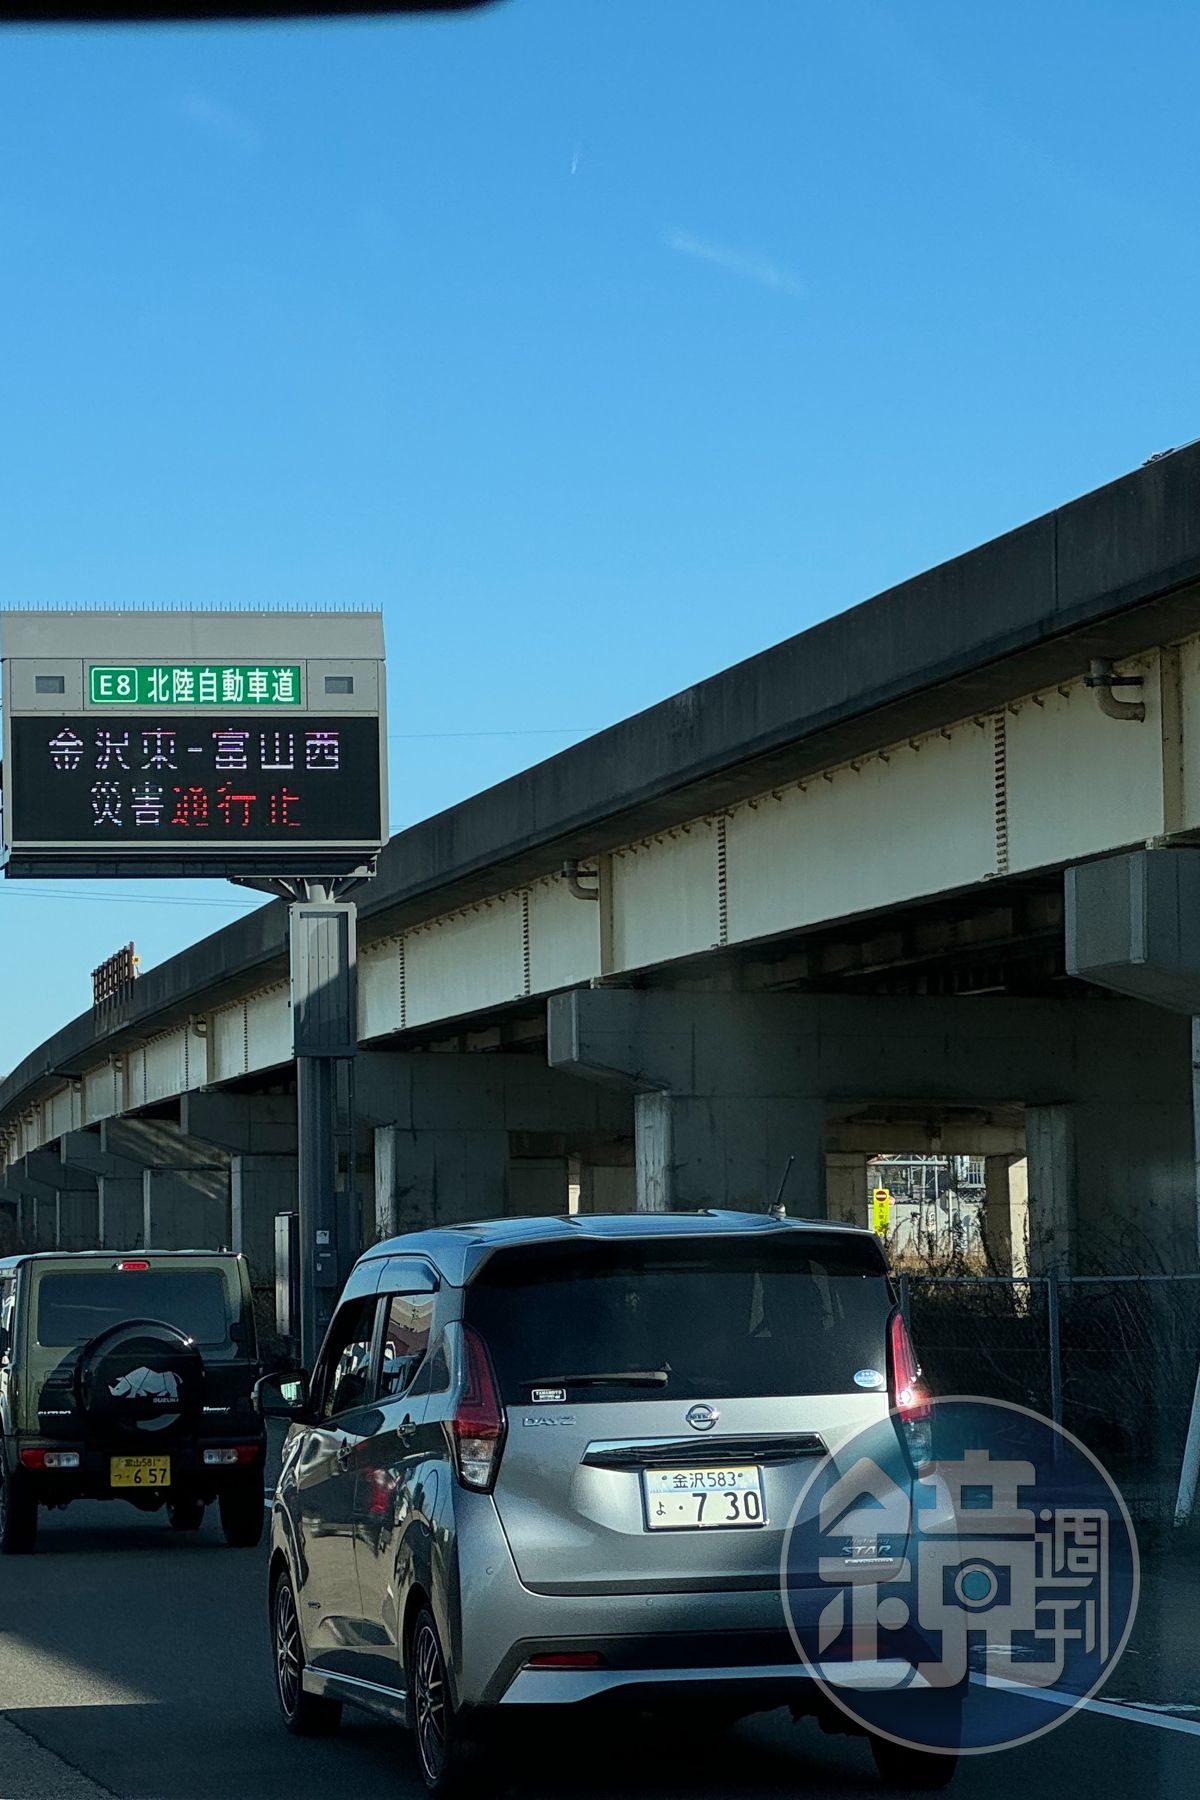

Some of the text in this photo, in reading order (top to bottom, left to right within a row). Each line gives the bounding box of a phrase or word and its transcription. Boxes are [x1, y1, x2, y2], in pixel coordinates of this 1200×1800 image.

[99, 667, 294, 703] E8 北陸自動車道
[842, 1545, 892, 1555] STAR
